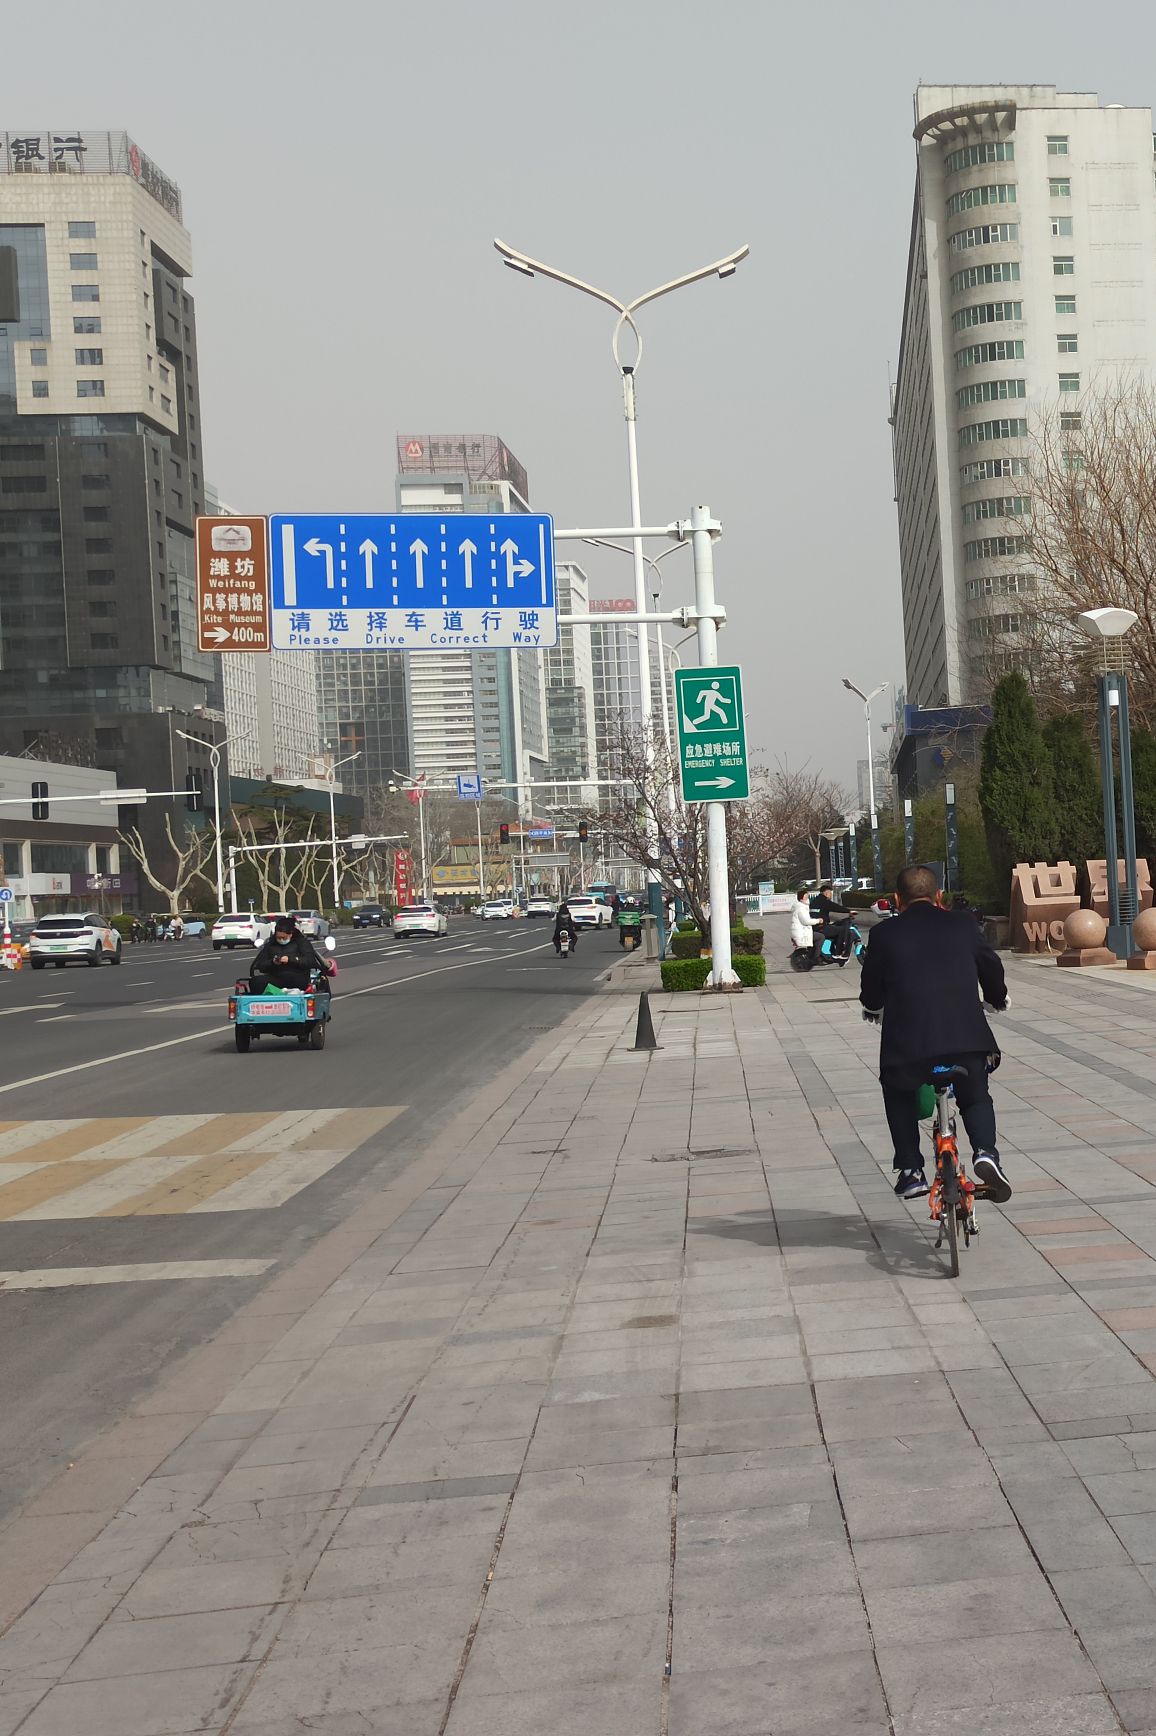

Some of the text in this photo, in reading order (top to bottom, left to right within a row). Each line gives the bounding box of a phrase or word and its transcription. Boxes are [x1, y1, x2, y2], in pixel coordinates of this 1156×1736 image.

[209, 557, 255, 577] 潍坊
[208, 578, 256, 590] Weifang
[203, 592, 263, 612] 风筝博物馆
[204, 613, 263, 624] Kite Museum
[288, 610, 540, 632] 请选择车道行驶
[231, 626, 264, 642] 400m
[289, 631, 541, 645] Please Drive Correct Way
[685, 741, 740, 758] 应急避难场所
[684, 757, 743, 769] EMERGENCY SHELTER
